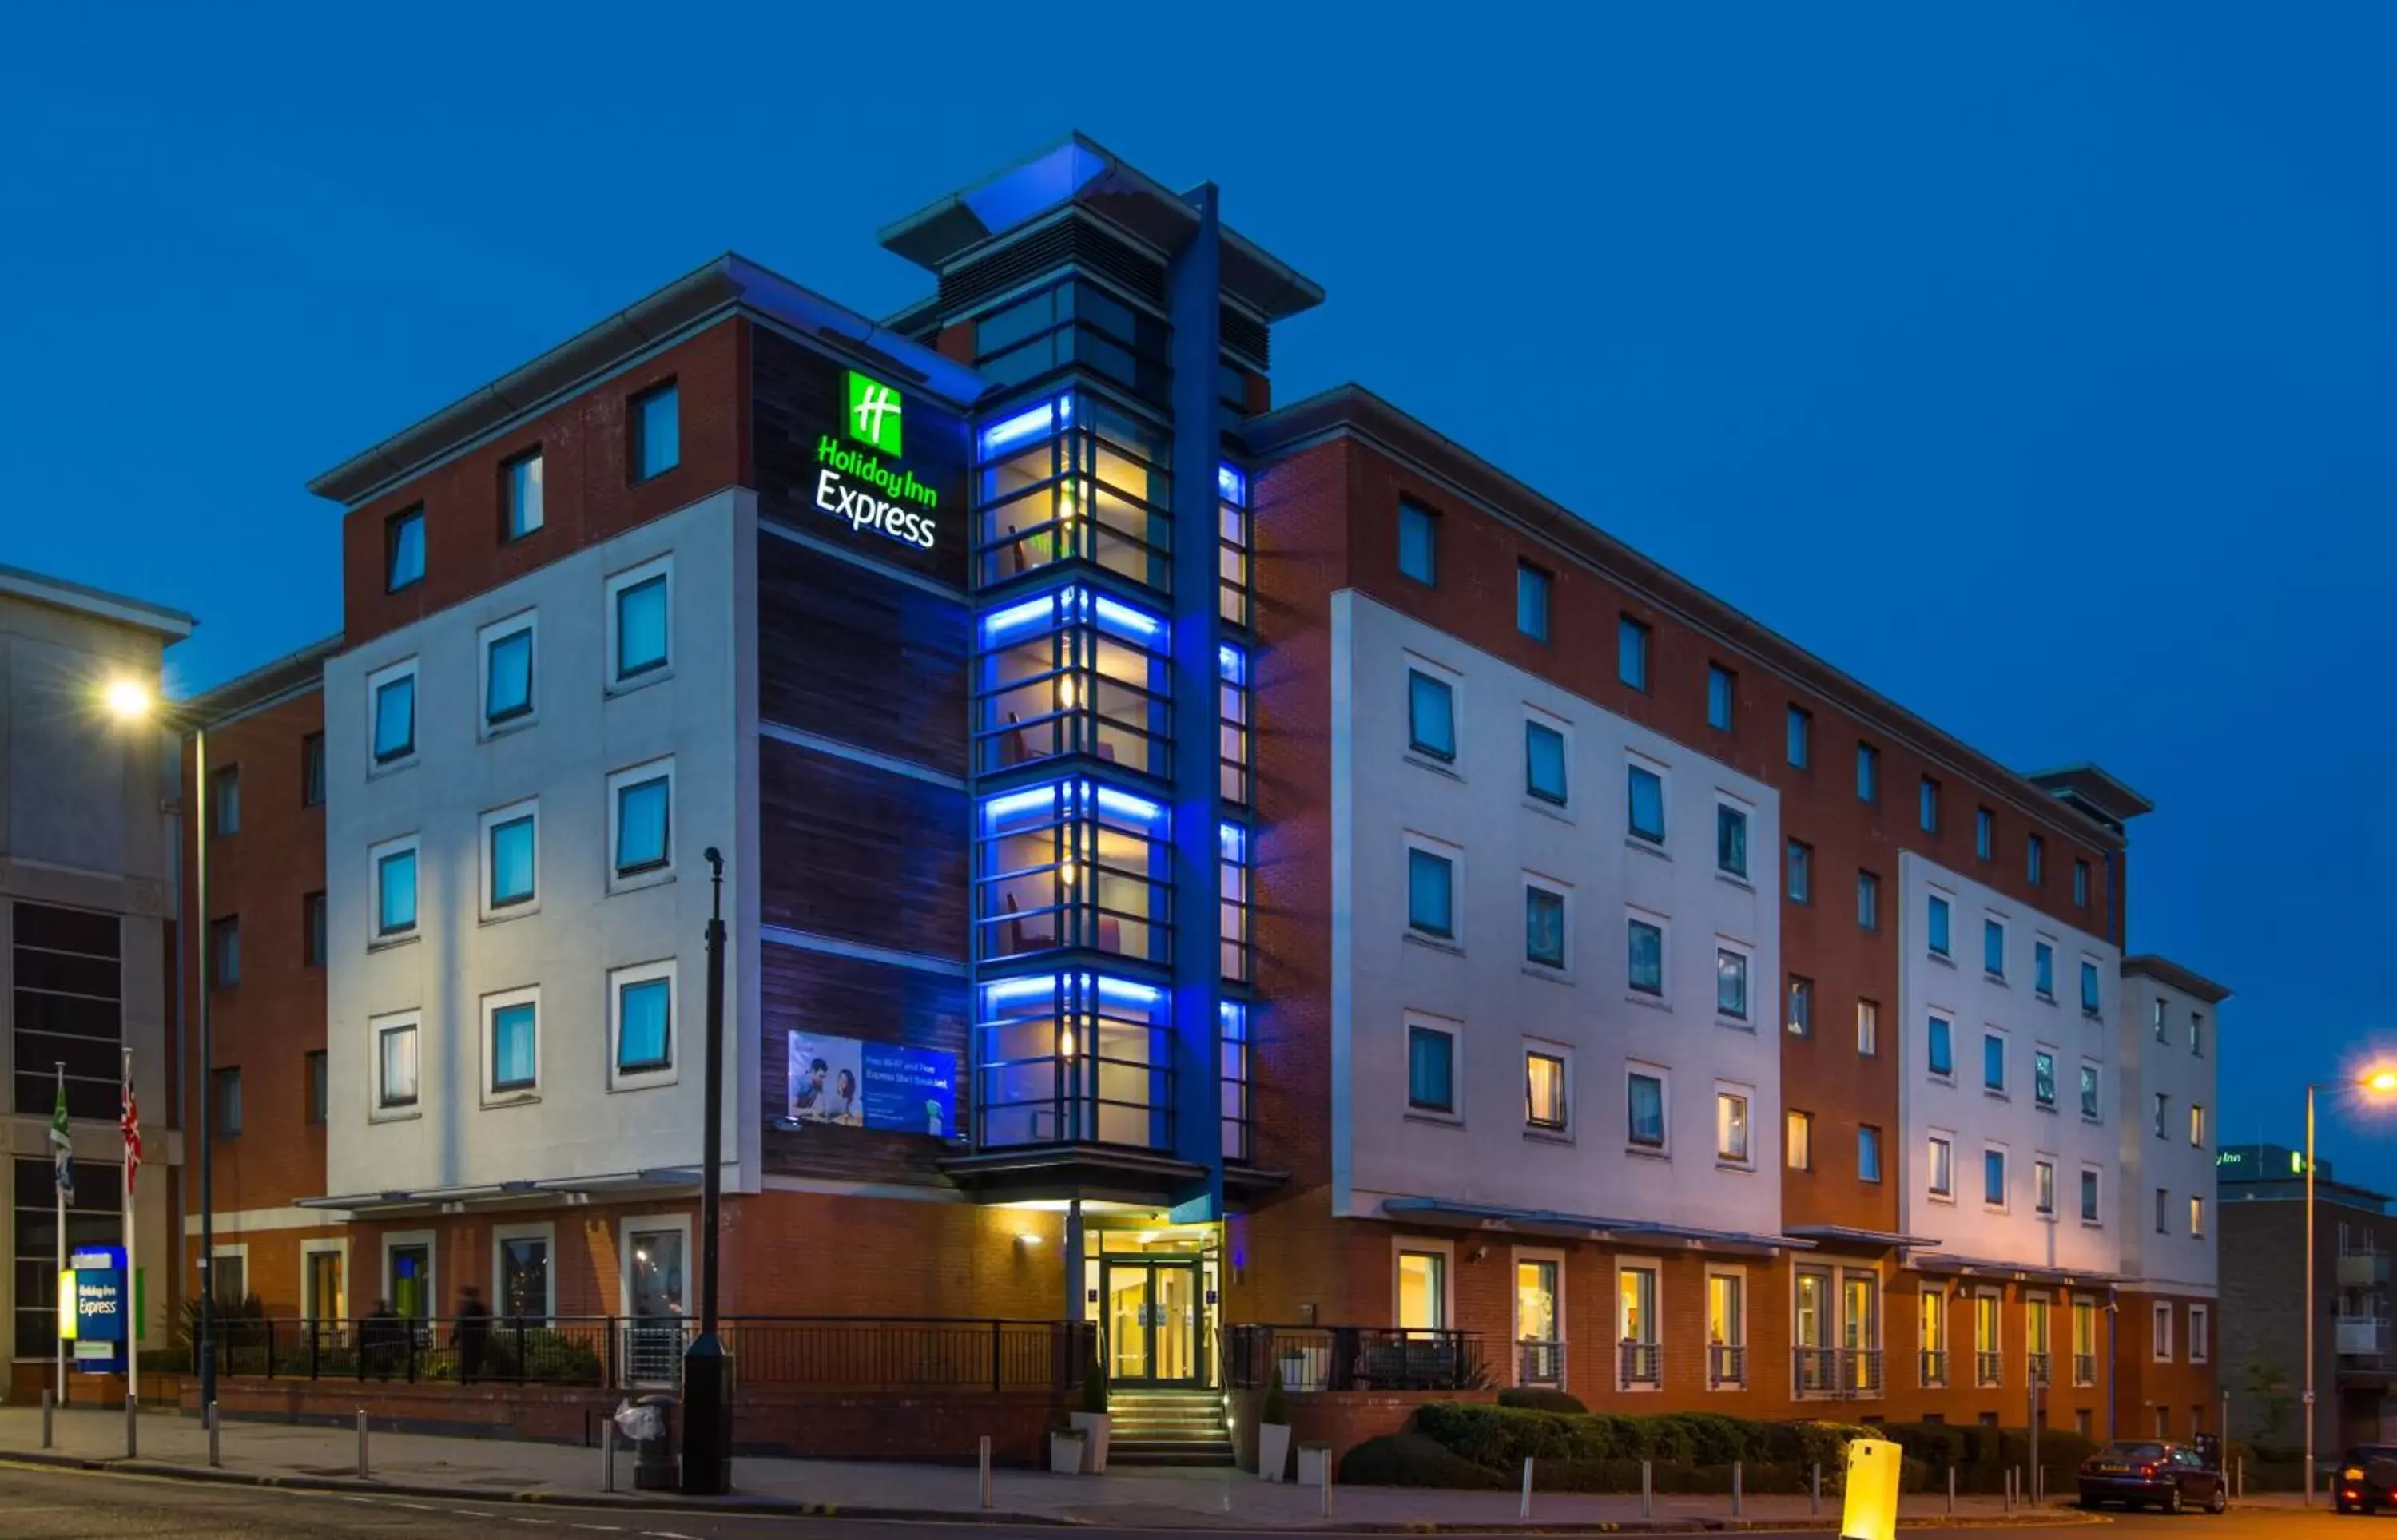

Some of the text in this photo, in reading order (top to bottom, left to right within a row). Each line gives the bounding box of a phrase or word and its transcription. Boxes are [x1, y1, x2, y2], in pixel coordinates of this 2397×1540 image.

[816, 468, 936, 548] Express
[817, 435, 938, 508] Holiday Inn
[79, 1298, 116, 1317] Express
